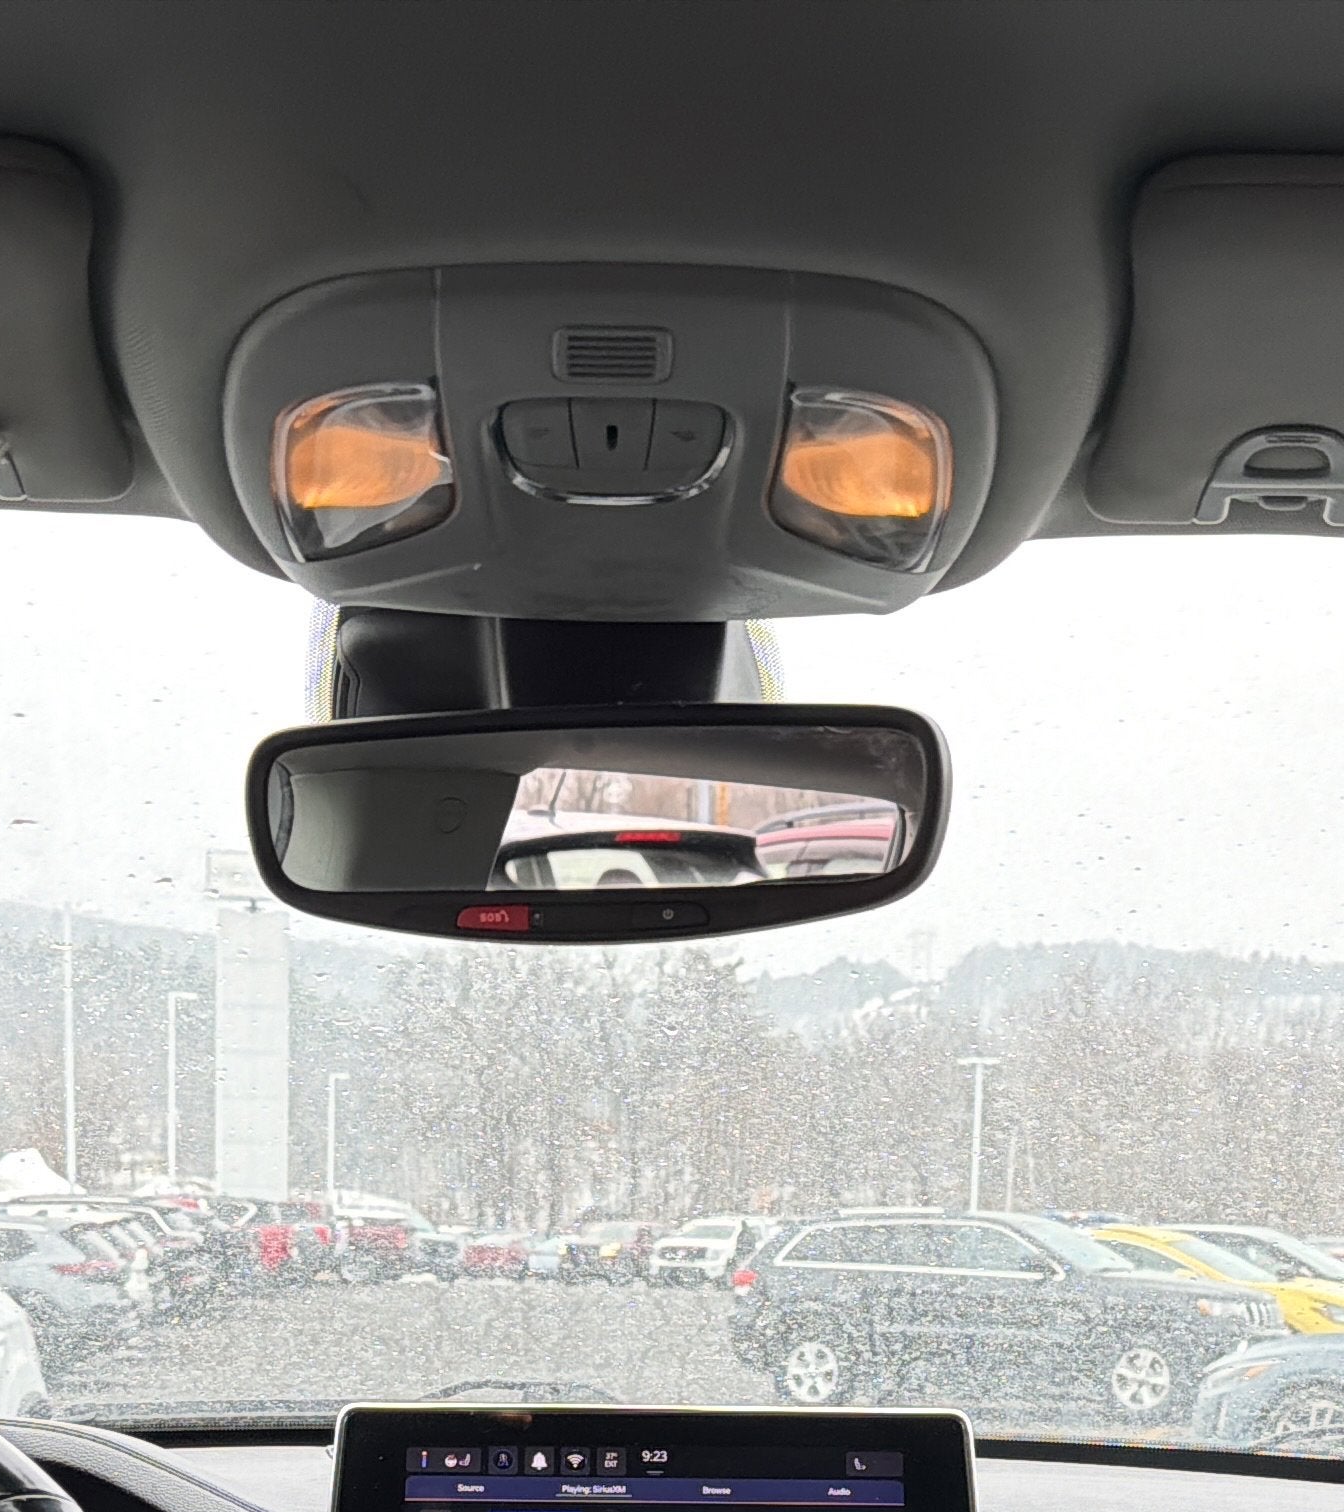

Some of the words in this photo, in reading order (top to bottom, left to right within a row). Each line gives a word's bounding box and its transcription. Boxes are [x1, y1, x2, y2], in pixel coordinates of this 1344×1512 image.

[641, 1450, 668, 1464] 9:23
[457, 1484, 485, 1494] Source
[561, 1484, 591, 1496] Playing:
[702, 1485, 731, 1496] Browse
[827, 1487, 851, 1497] Audio
